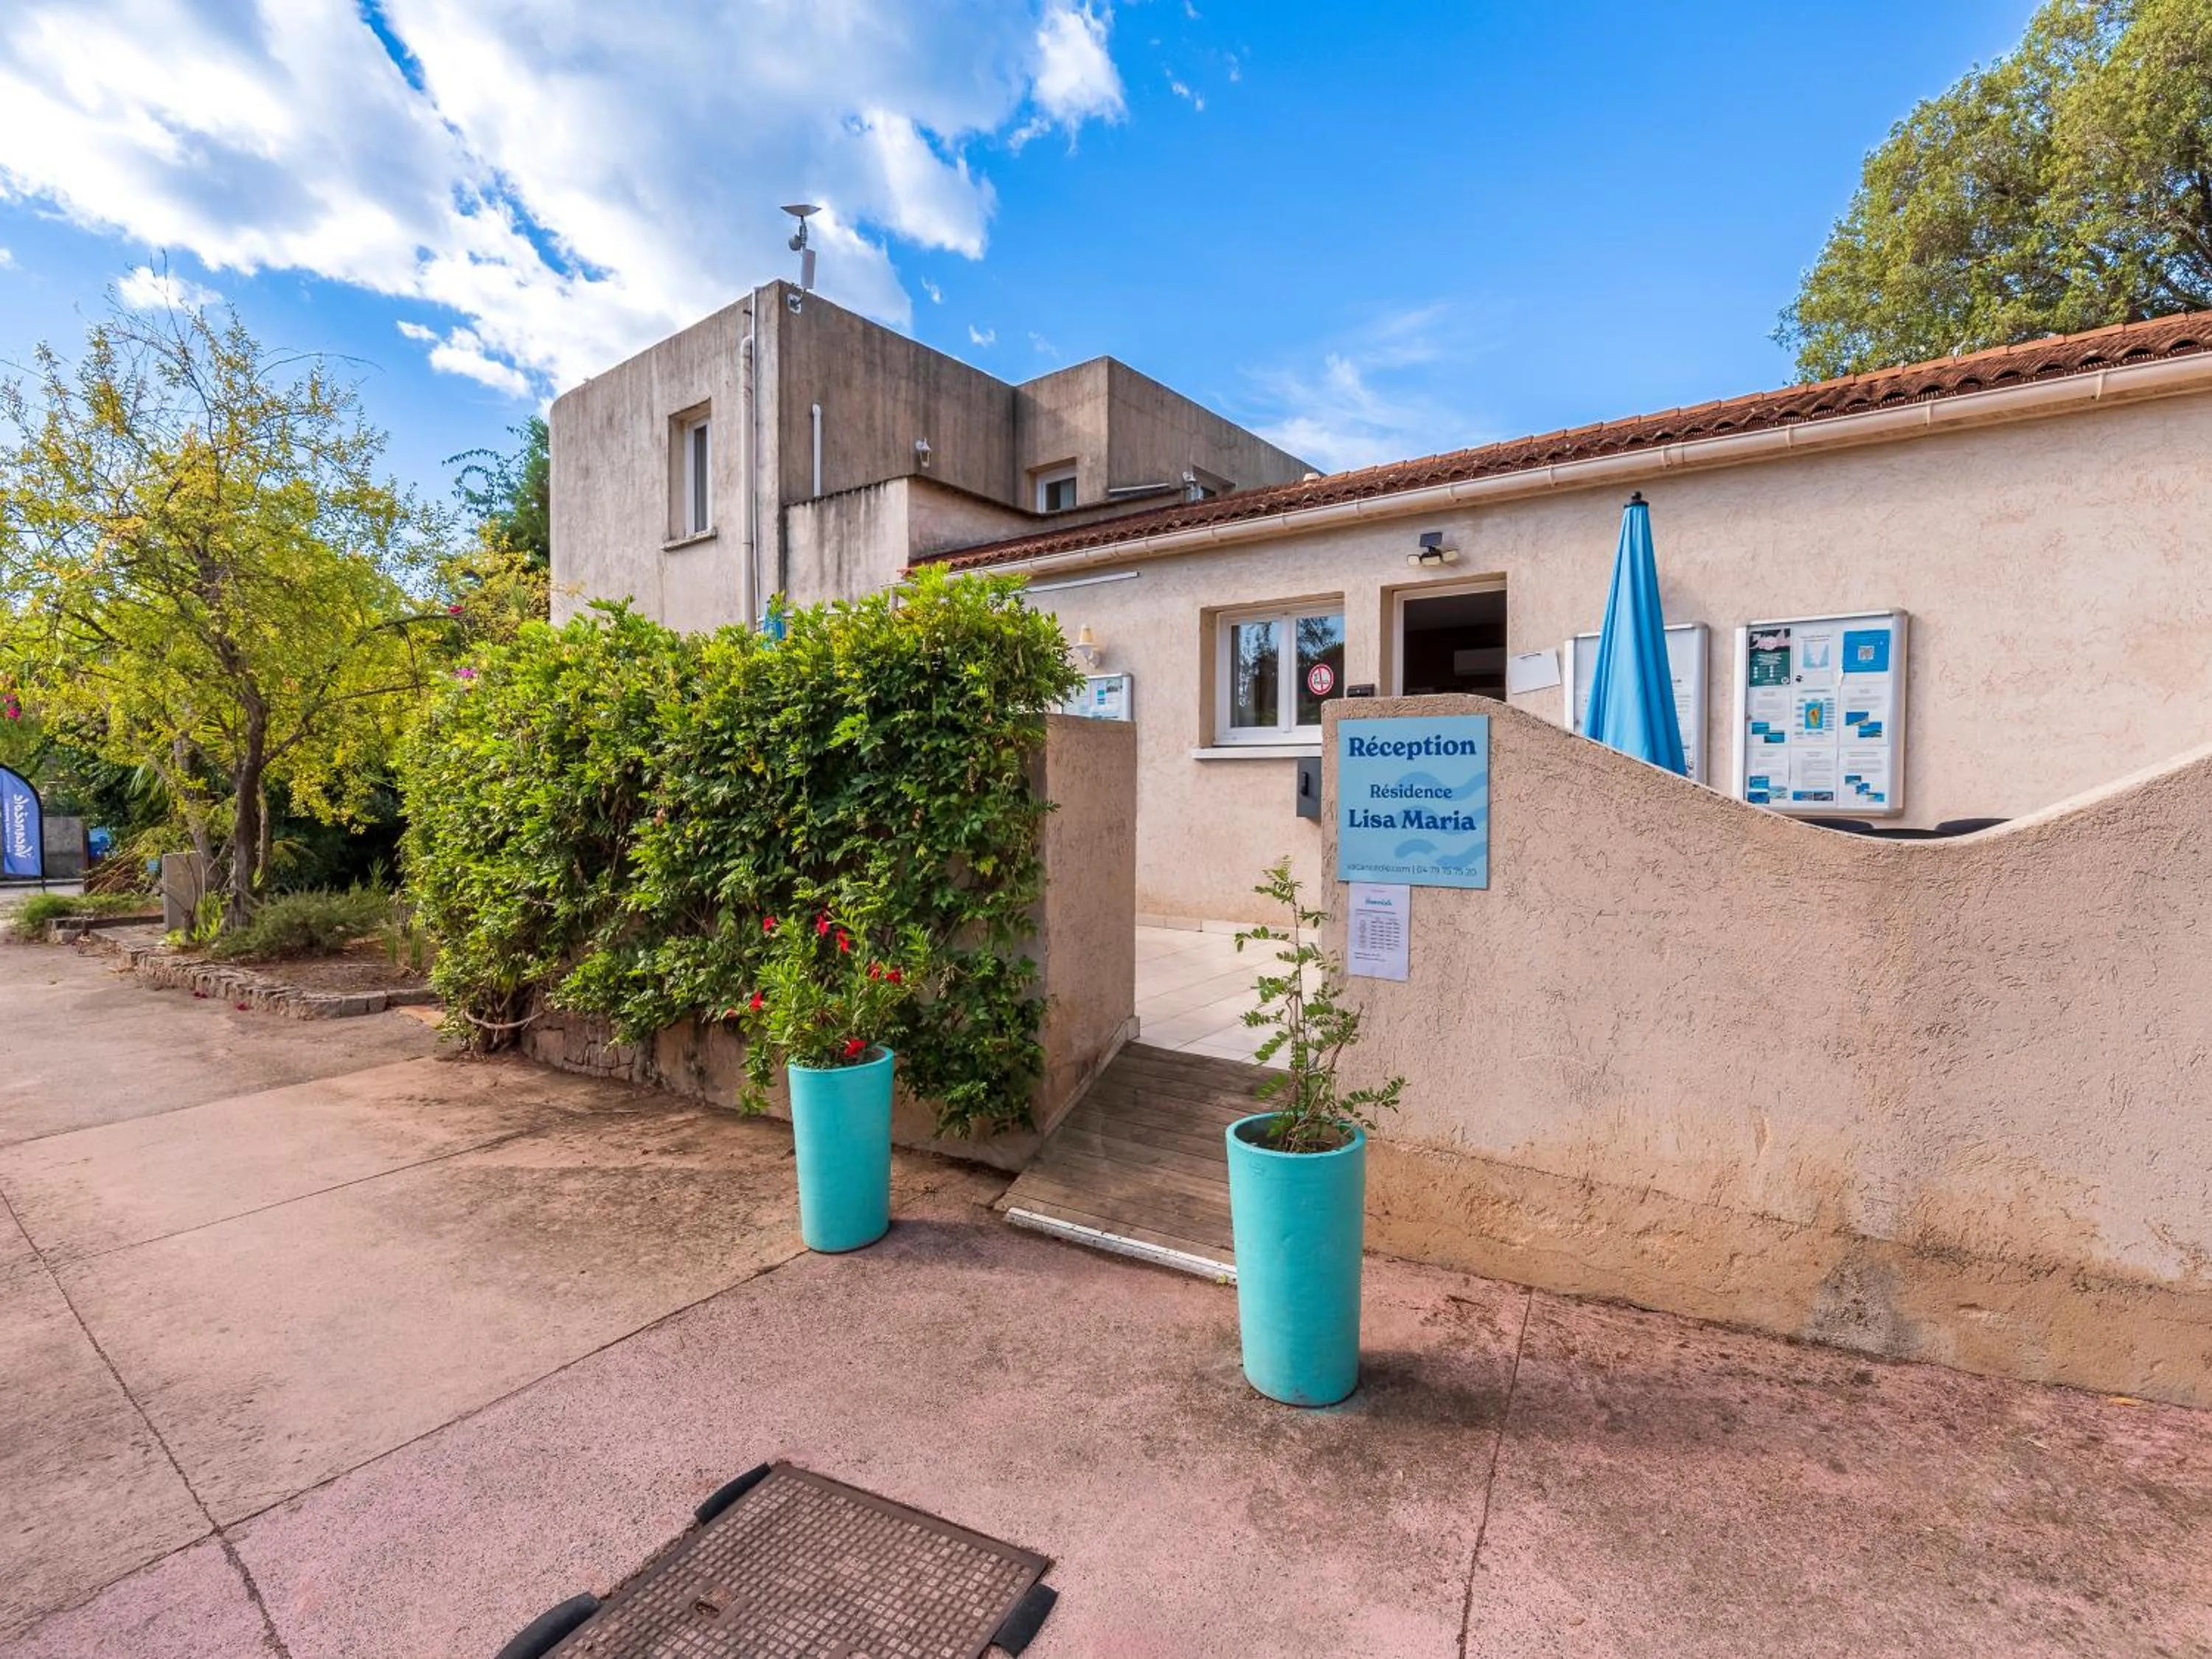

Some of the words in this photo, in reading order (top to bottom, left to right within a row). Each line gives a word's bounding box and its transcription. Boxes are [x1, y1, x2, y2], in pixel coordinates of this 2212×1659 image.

[1349, 734, 1477, 760] Réception
[1370, 783, 1453, 799] Résidence
[1349, 809, 1397, 828] Lisa
[1401, 810, 1477, 830] Maria
